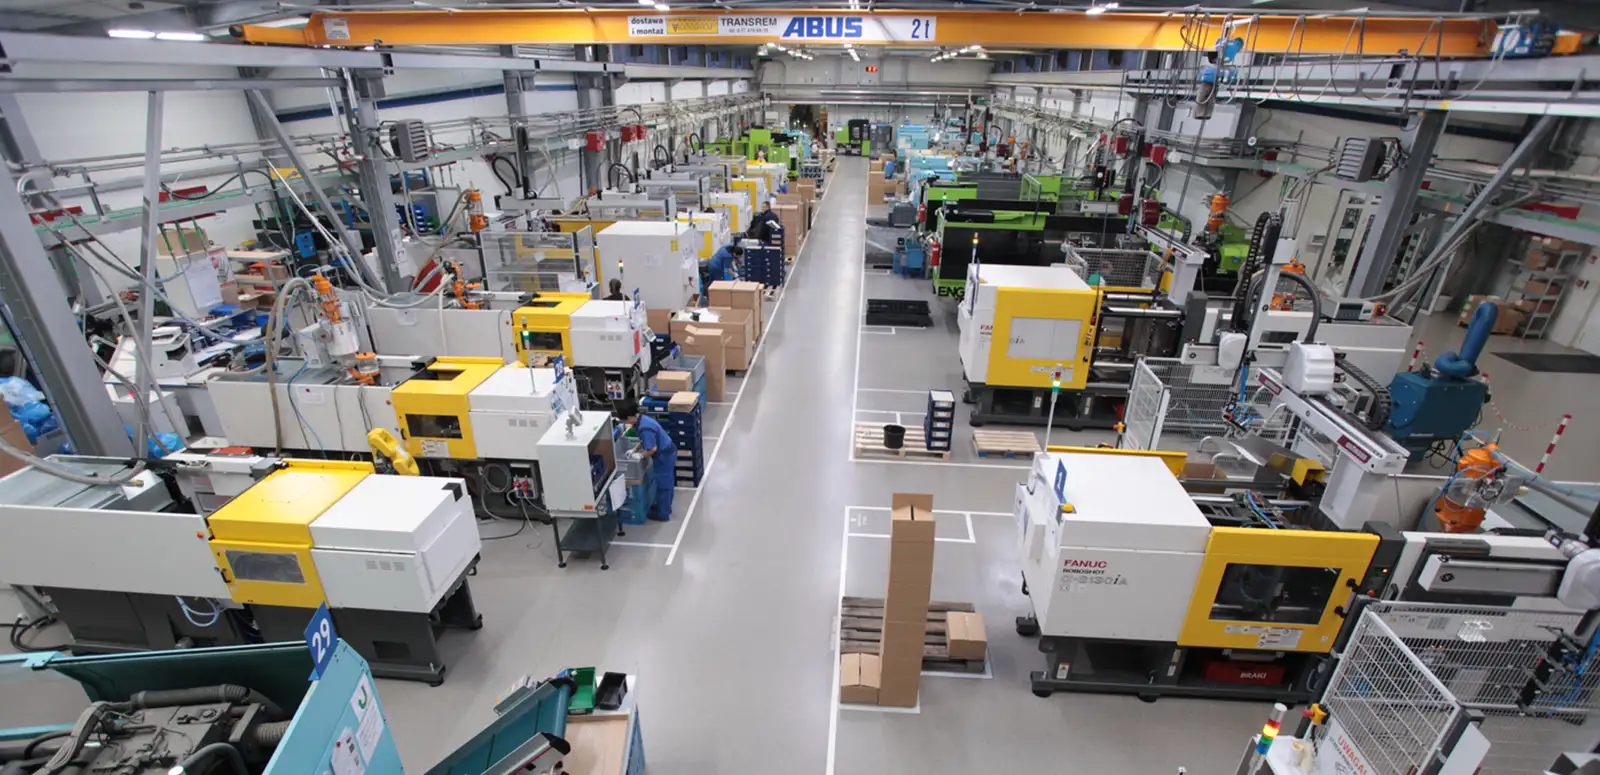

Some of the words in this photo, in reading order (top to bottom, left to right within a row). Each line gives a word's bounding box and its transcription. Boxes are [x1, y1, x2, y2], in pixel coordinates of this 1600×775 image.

[721, 18, 777, 26] TRANSREM
[782, 16, 863, 38] ABUS
[636, 27, 664, 35] montaż
[911, 18, 921, 39] 2
[938, 286, 965, 297] ENG
[1064, 559, 1107, 569] FANUC
[312, 618, 331, 664] 29
[1240, 672, 1267, 680] BRAKI
